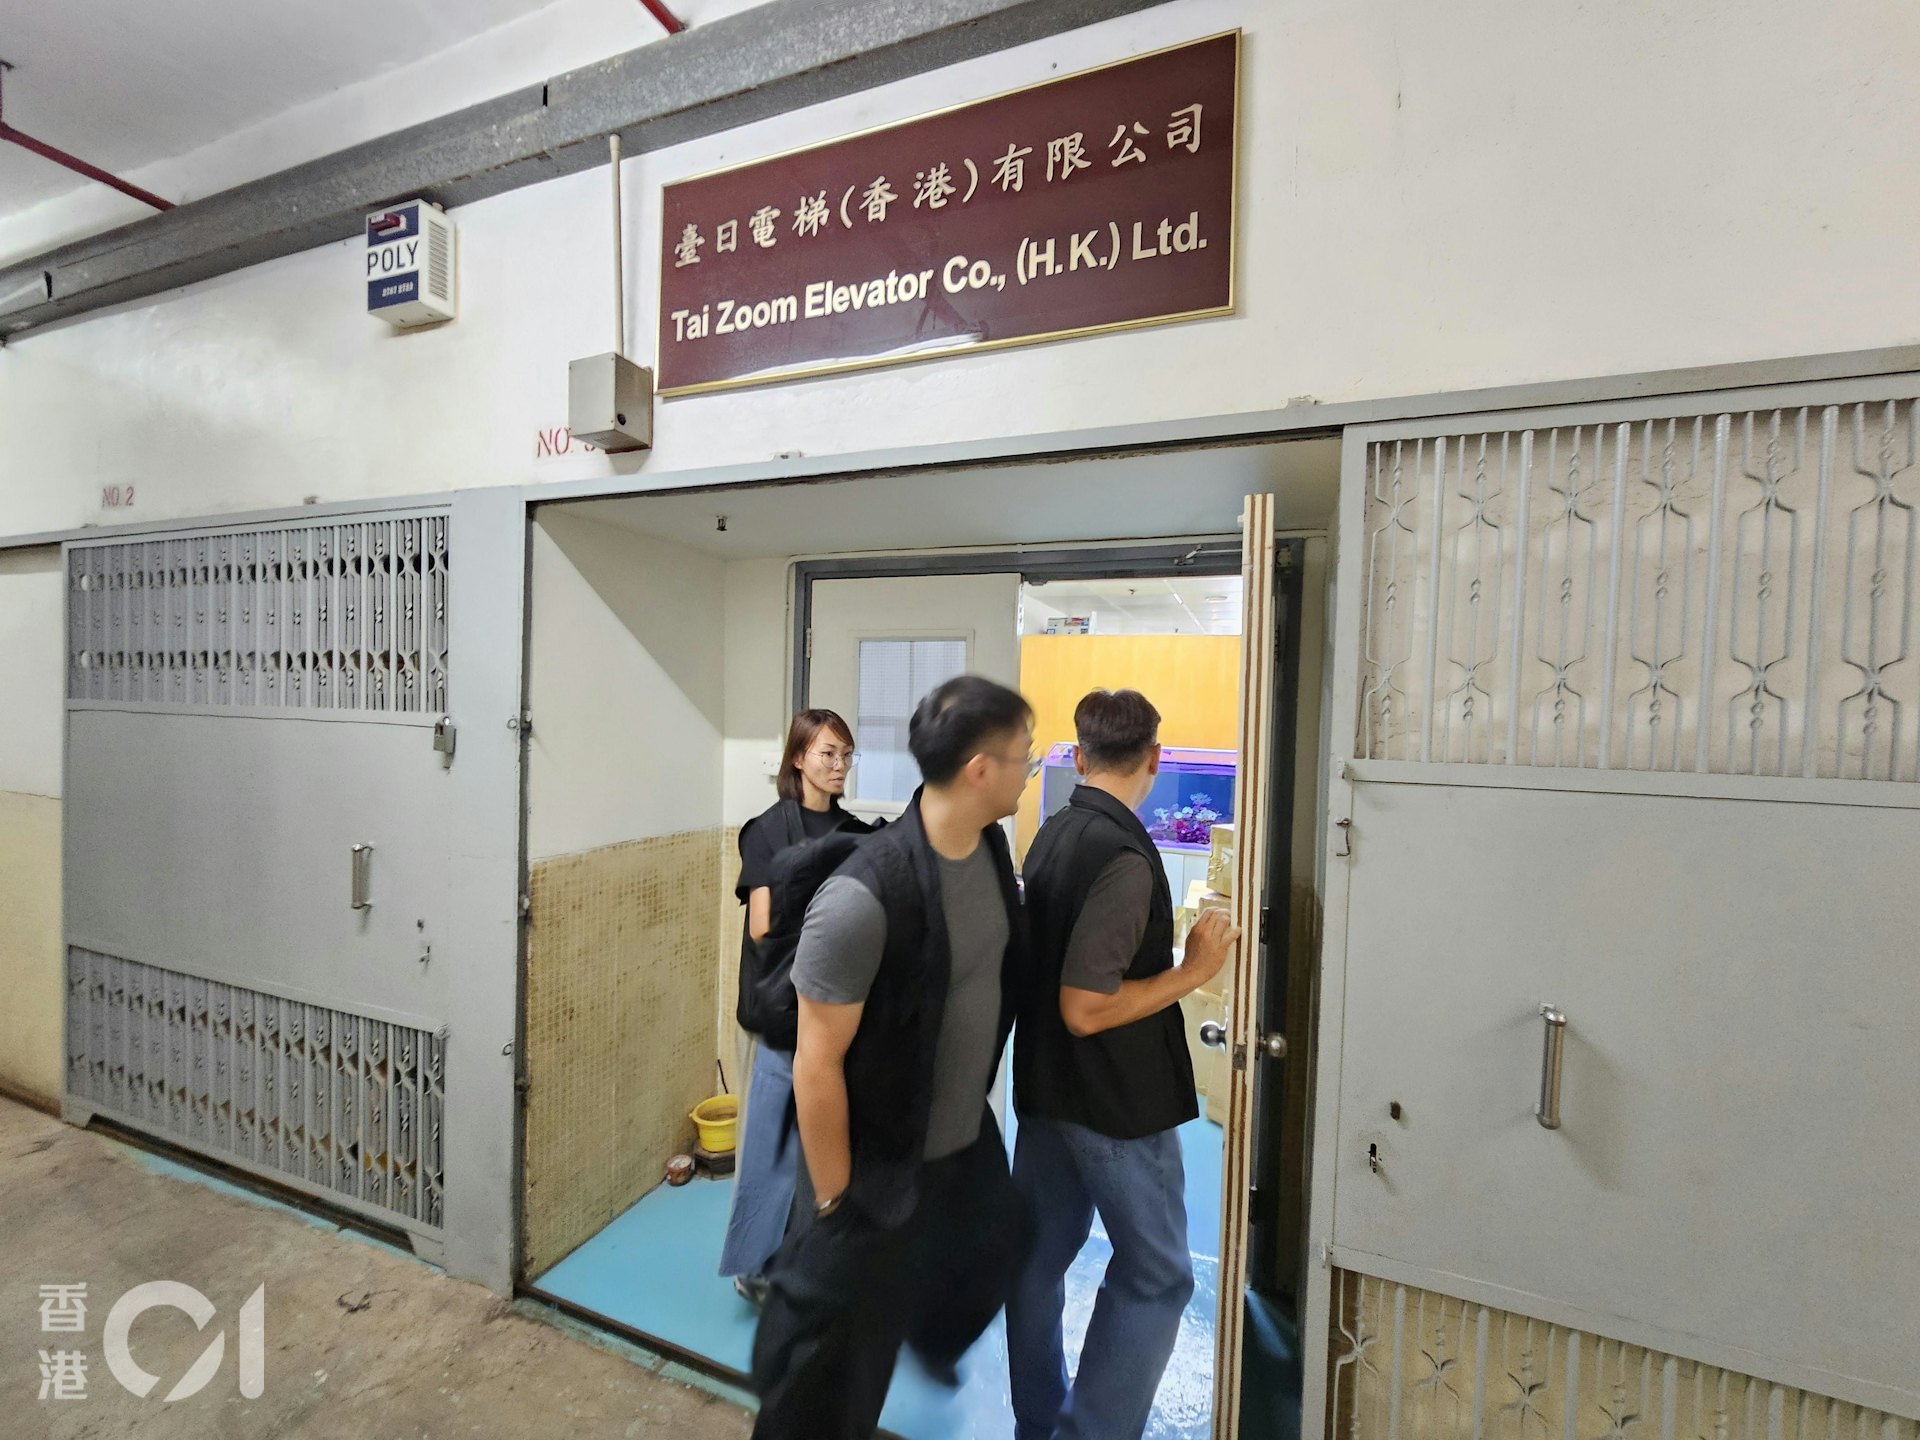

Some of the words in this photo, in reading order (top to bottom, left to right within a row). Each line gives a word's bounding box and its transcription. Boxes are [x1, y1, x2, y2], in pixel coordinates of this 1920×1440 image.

[367, 240, 419, 276] POLY
[671, 304, 710, 342] Tai
[715, 294, 798, 335] Zoom
[804, 268, 934, 319] Elevator
[943, 255, 1006, 294] Co.,
[1132, 211, 1208, 261] Ltd.
[126, 486, 135, 506] 2
